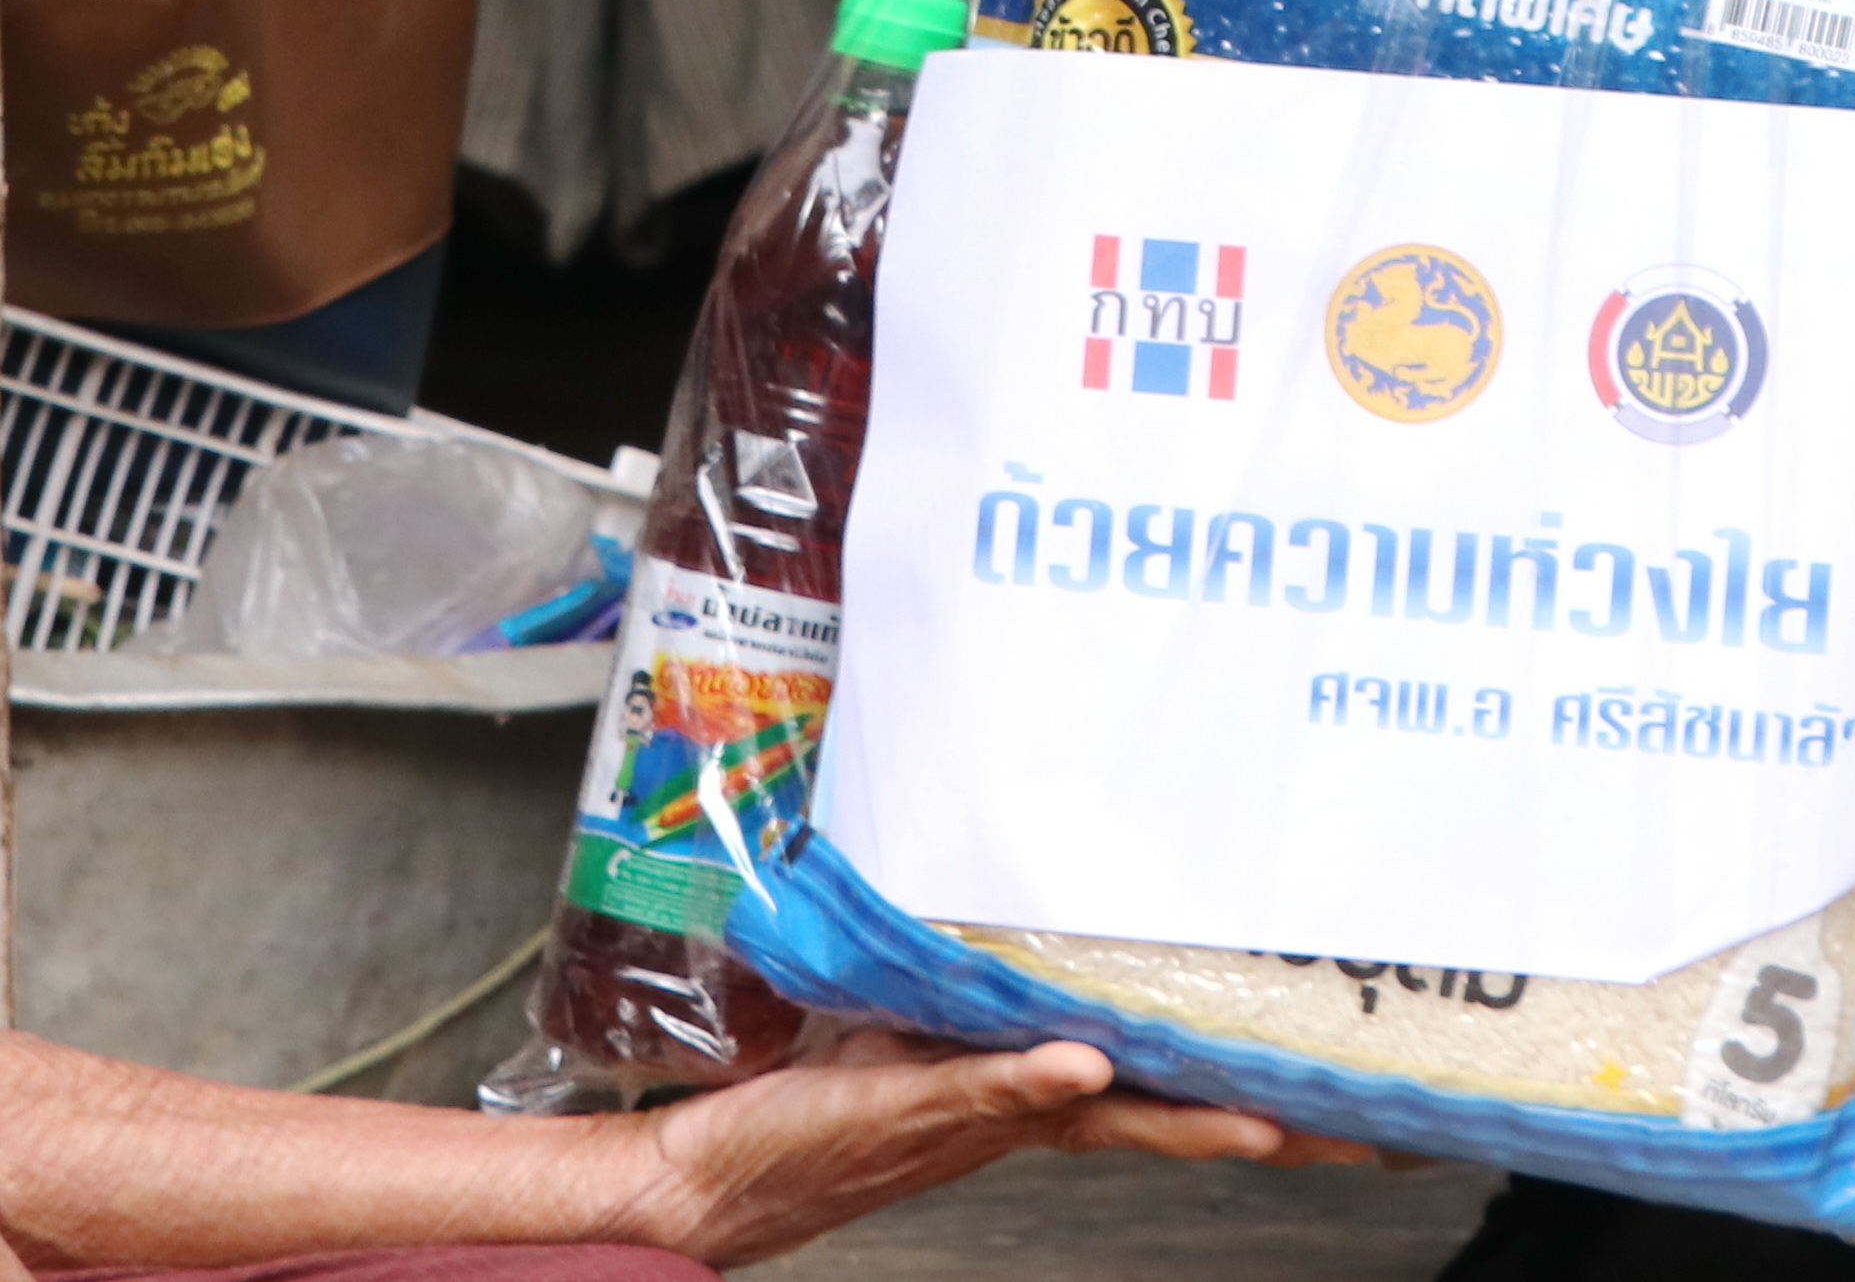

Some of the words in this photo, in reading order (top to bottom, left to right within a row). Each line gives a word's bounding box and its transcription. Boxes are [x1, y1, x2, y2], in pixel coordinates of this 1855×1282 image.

[1730, 29, 1784, 51] 859485
[1797, 43, 1851, 65] 800023
[971, 461, 1836, 656] ด้วยความห่วงใย
[1308, 671, 1513, 742] ศจพ.อ
[1719, 963, 1819, 1084] 5
